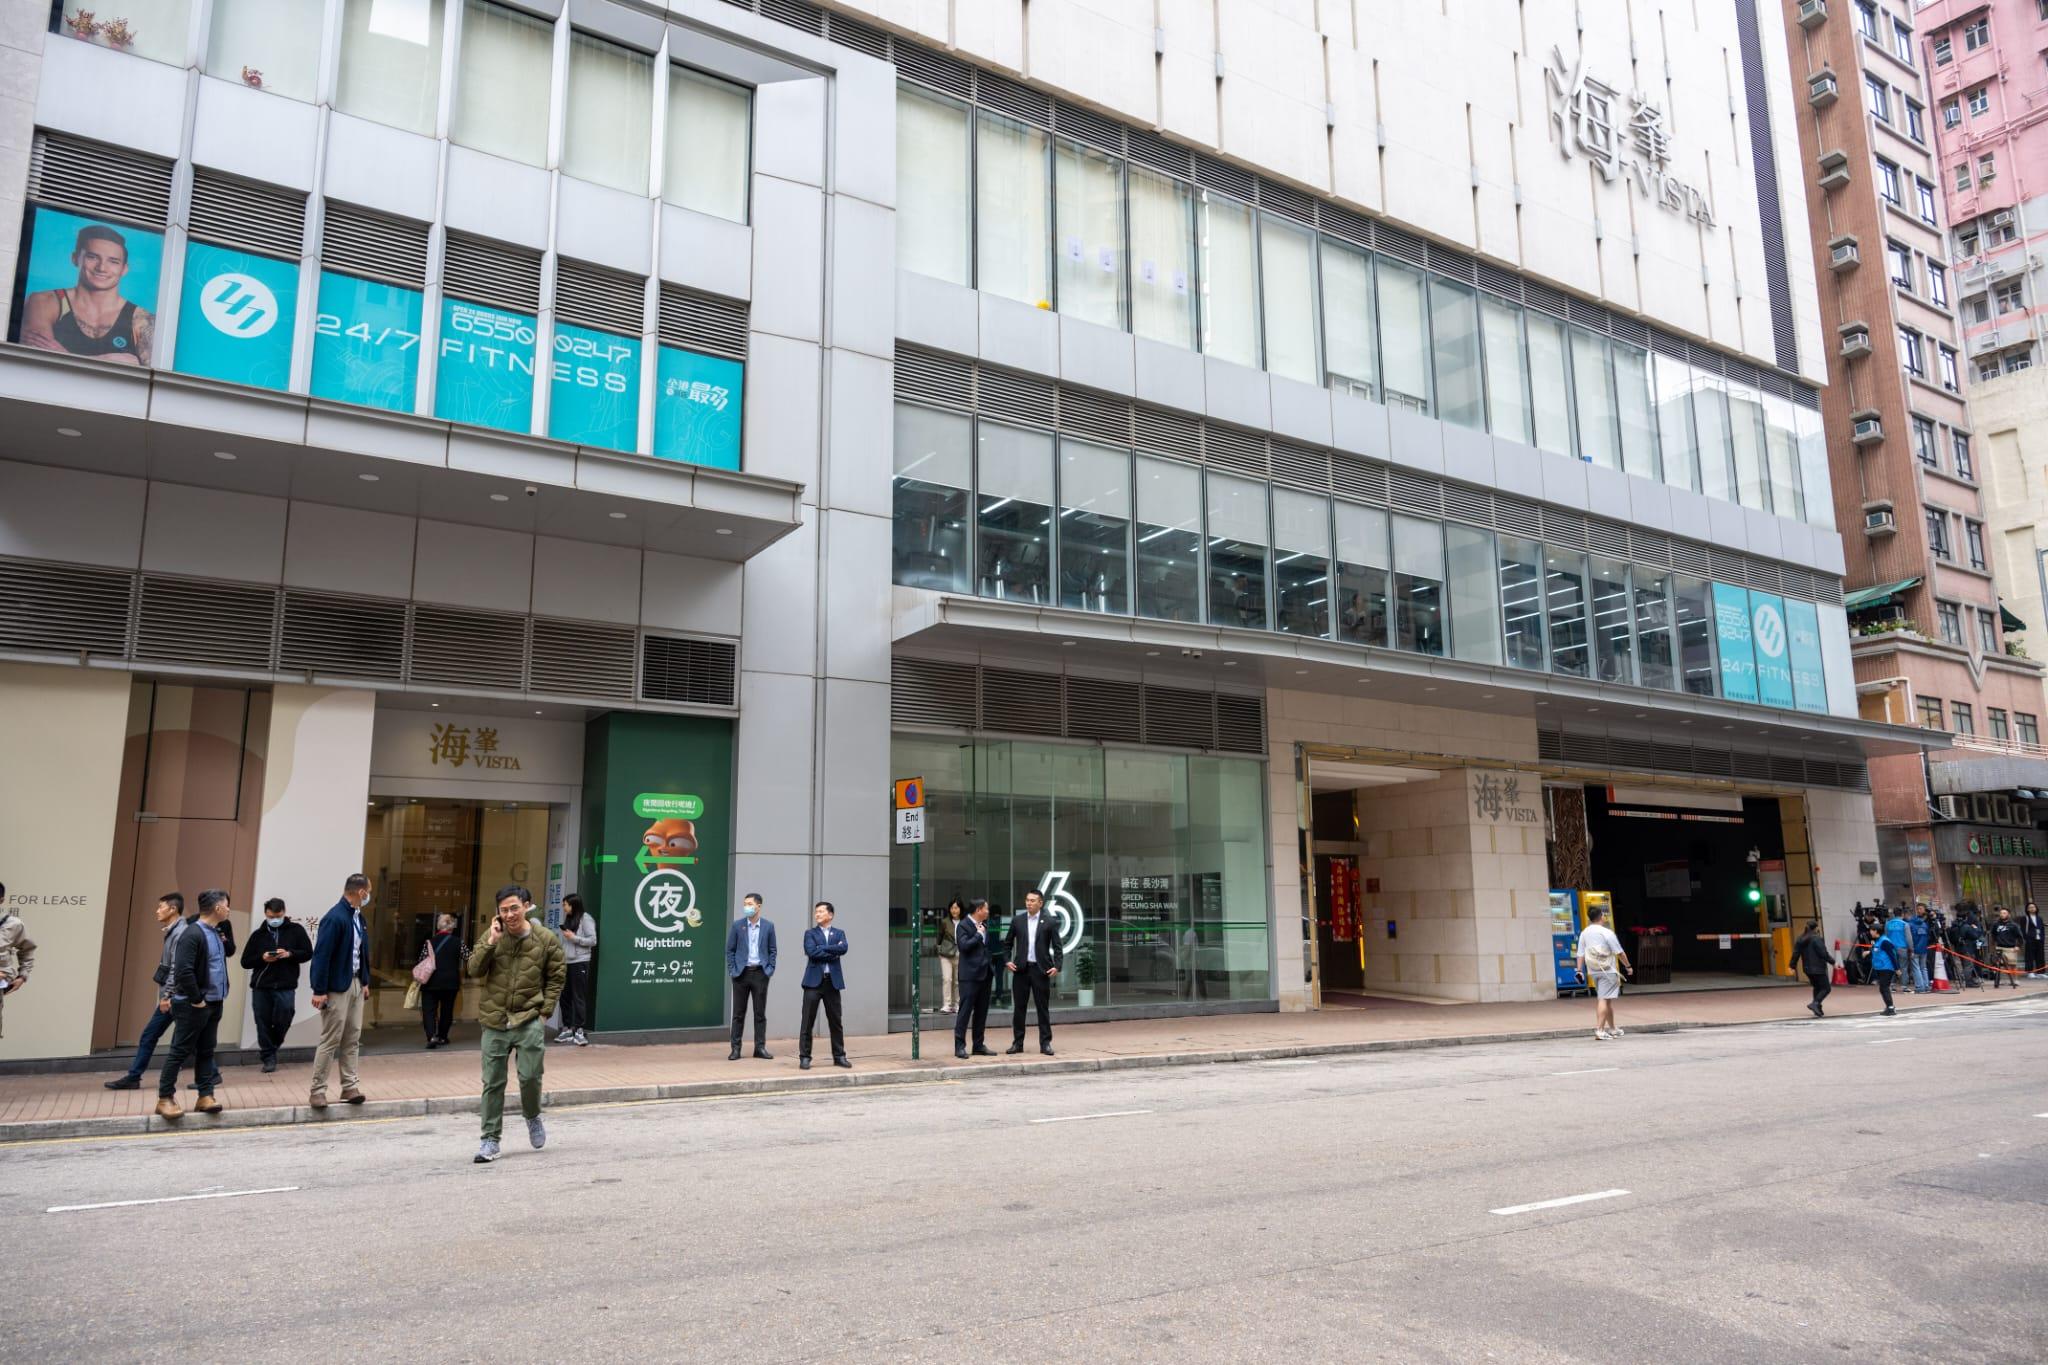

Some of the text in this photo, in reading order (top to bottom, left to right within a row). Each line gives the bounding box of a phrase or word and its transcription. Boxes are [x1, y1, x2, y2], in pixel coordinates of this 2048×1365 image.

[1633, 160, 1717, 228] VISTA
[316, 314, 420, 351] 24/7
[452, 313, 631, 365] 6550 0247
[1721, 657, 1755, 676] 24/7
[473, 755, 522, 770] VISTA
[905, 811, 919, 822] End
[1504, 807, 1538, 823] VISTA
[9, 895, 87, 906] FOR LEASE
[648, 882, 684, 919] 夜
[1121, 902, 1149, 910] CHEUNG
[634, 937, 692, 950] Nighttime
[631, 961, 642, 976] 7
[669, 960, 680, 976] 9
